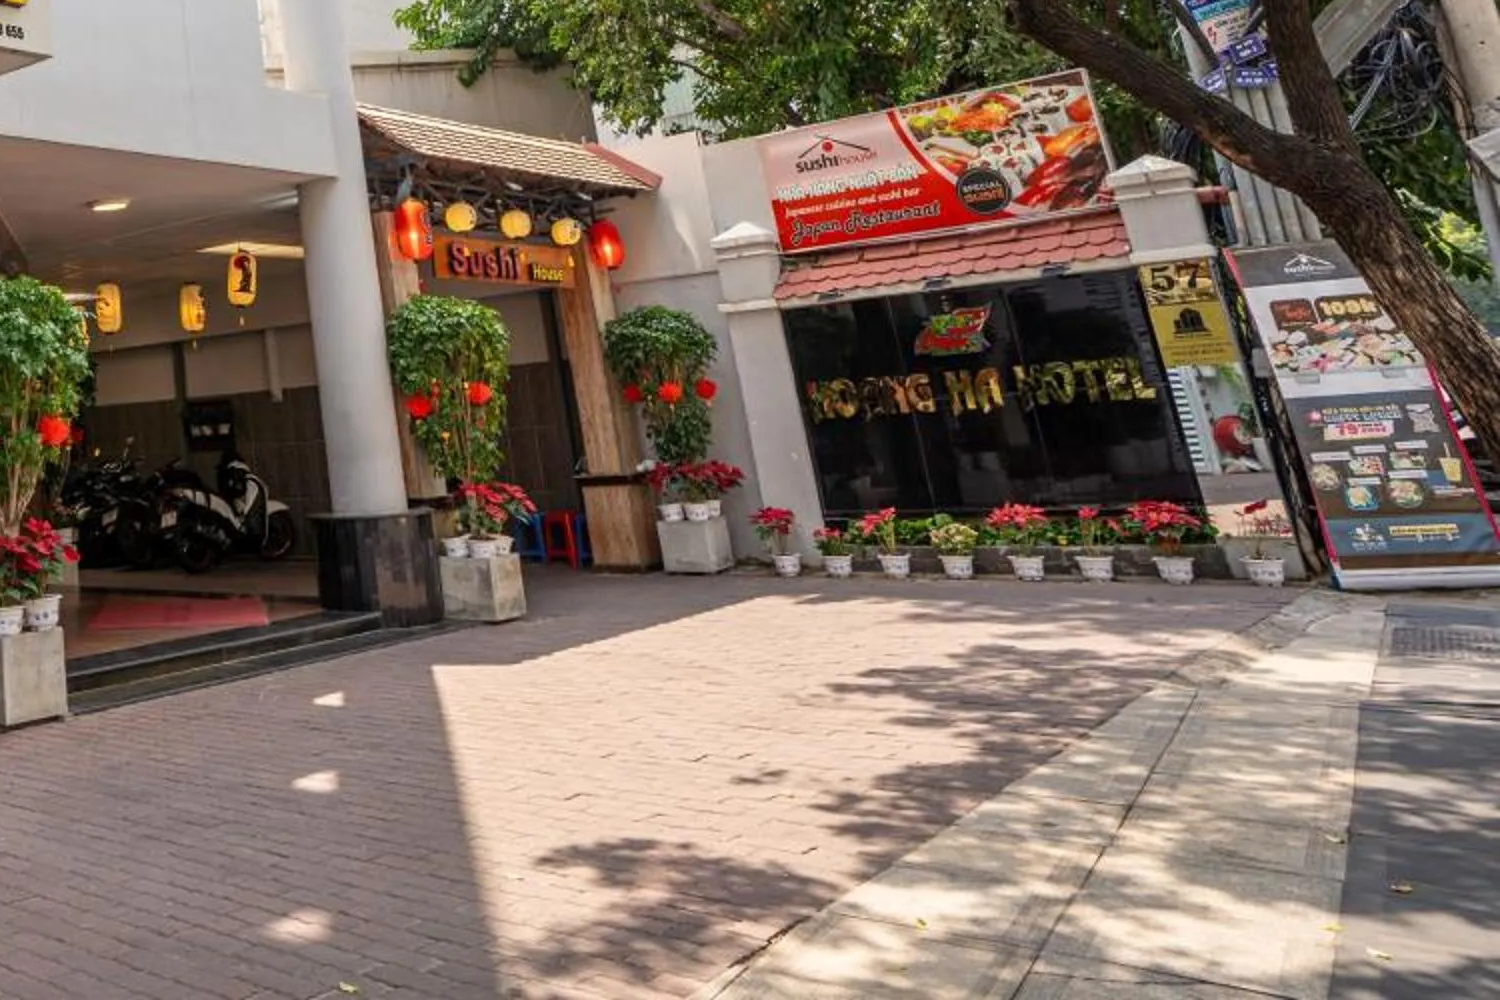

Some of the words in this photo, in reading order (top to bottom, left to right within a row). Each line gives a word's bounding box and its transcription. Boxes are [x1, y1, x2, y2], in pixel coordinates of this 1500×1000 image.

[791, 218, 842, 246] Japan
[844, 199, 941, 235] Restaurant
[451, 240, 521, 280] Sushi
[1151, 262, 1200, 292] 57
